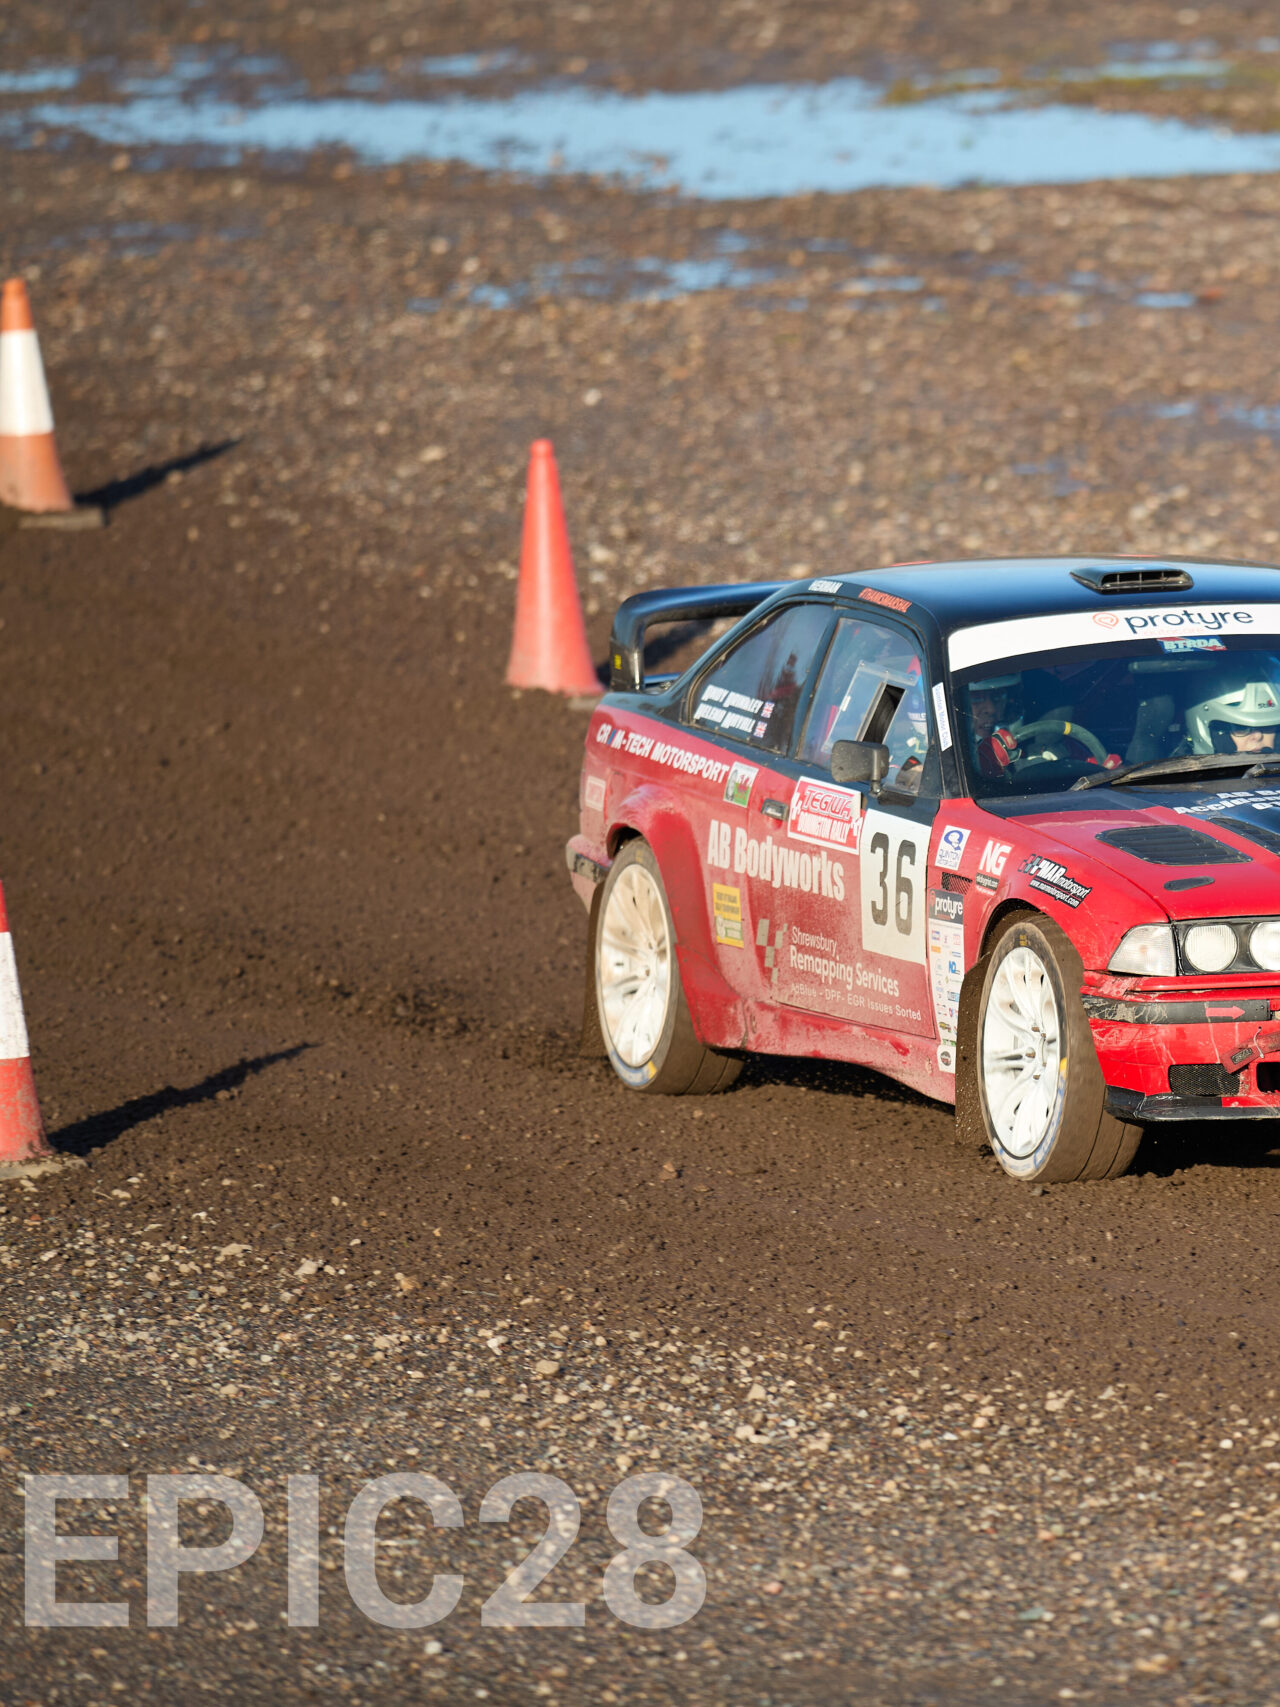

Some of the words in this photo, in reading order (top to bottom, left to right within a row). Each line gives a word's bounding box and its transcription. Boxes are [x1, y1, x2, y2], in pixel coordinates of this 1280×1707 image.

[1124, 610, 1254, 634] protyre
[651, 741, 730, 783] MOTORSPORT
[801, 786, 853, 820] TEGIWA
[707, 819, 731, 870] AB
[734, 826, 846, 901] Bodyworks
[979, 840, 1012, 876] NG
[869, 831, 917, 937] 36
[935, 897, 963, 919] protyre
[792, 926, 837, 957] Shrewsbury
[790, 945, 853, 990] Remapping
[856, 962, 899, 997] Services
[847, 993, 865, 1008] EGR
[867, 998, 894, 1015] Issues
[895, 1004, 922, 1021] Sorted
